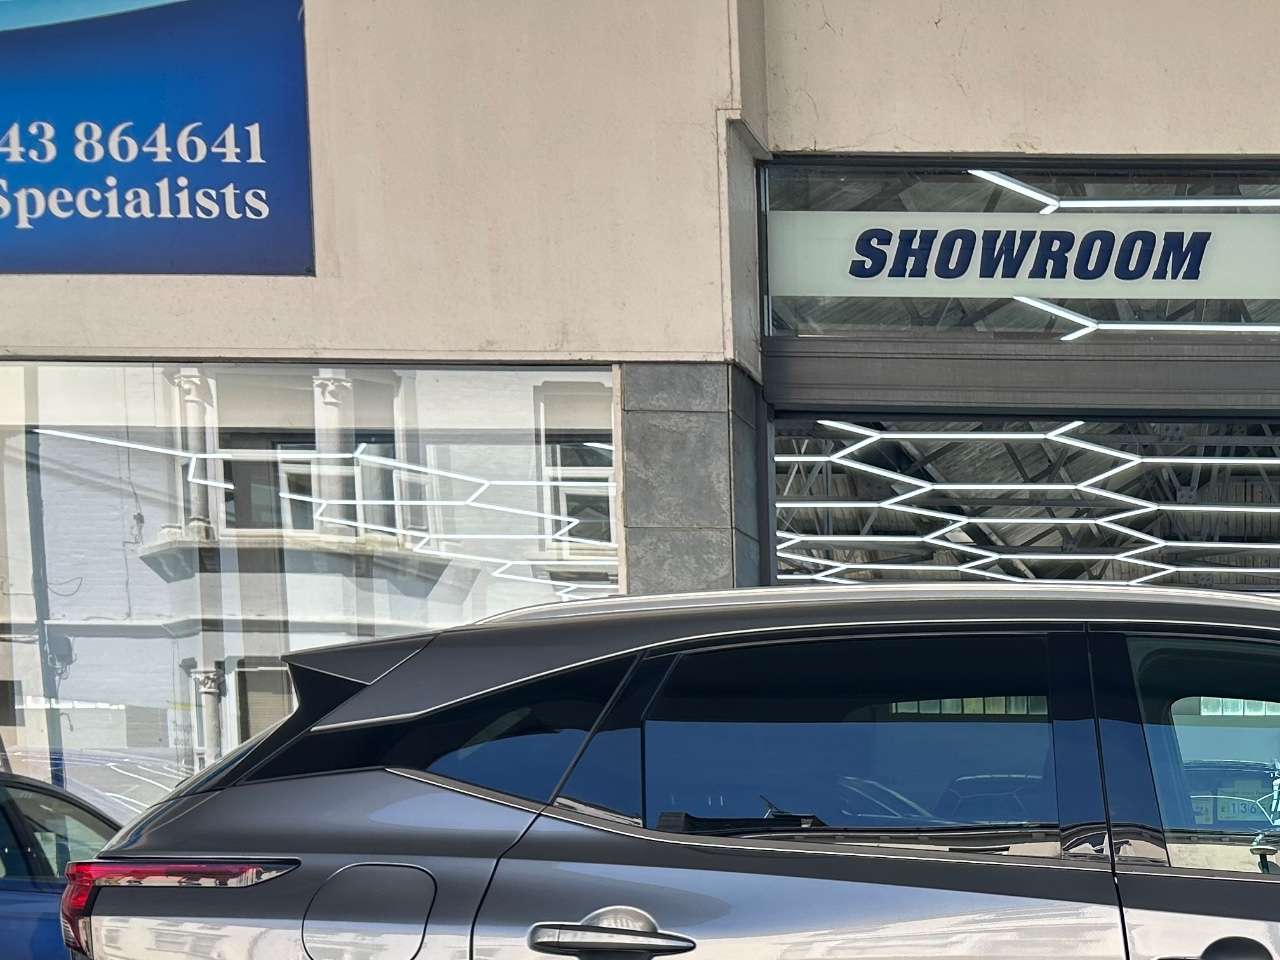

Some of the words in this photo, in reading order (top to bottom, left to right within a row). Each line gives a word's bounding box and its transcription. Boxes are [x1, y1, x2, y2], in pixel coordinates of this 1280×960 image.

[0, 121, 57, 163] 43
[74, 121, 267, 163] 864641
[848, 228, 1212, 281] SHOWROOM
